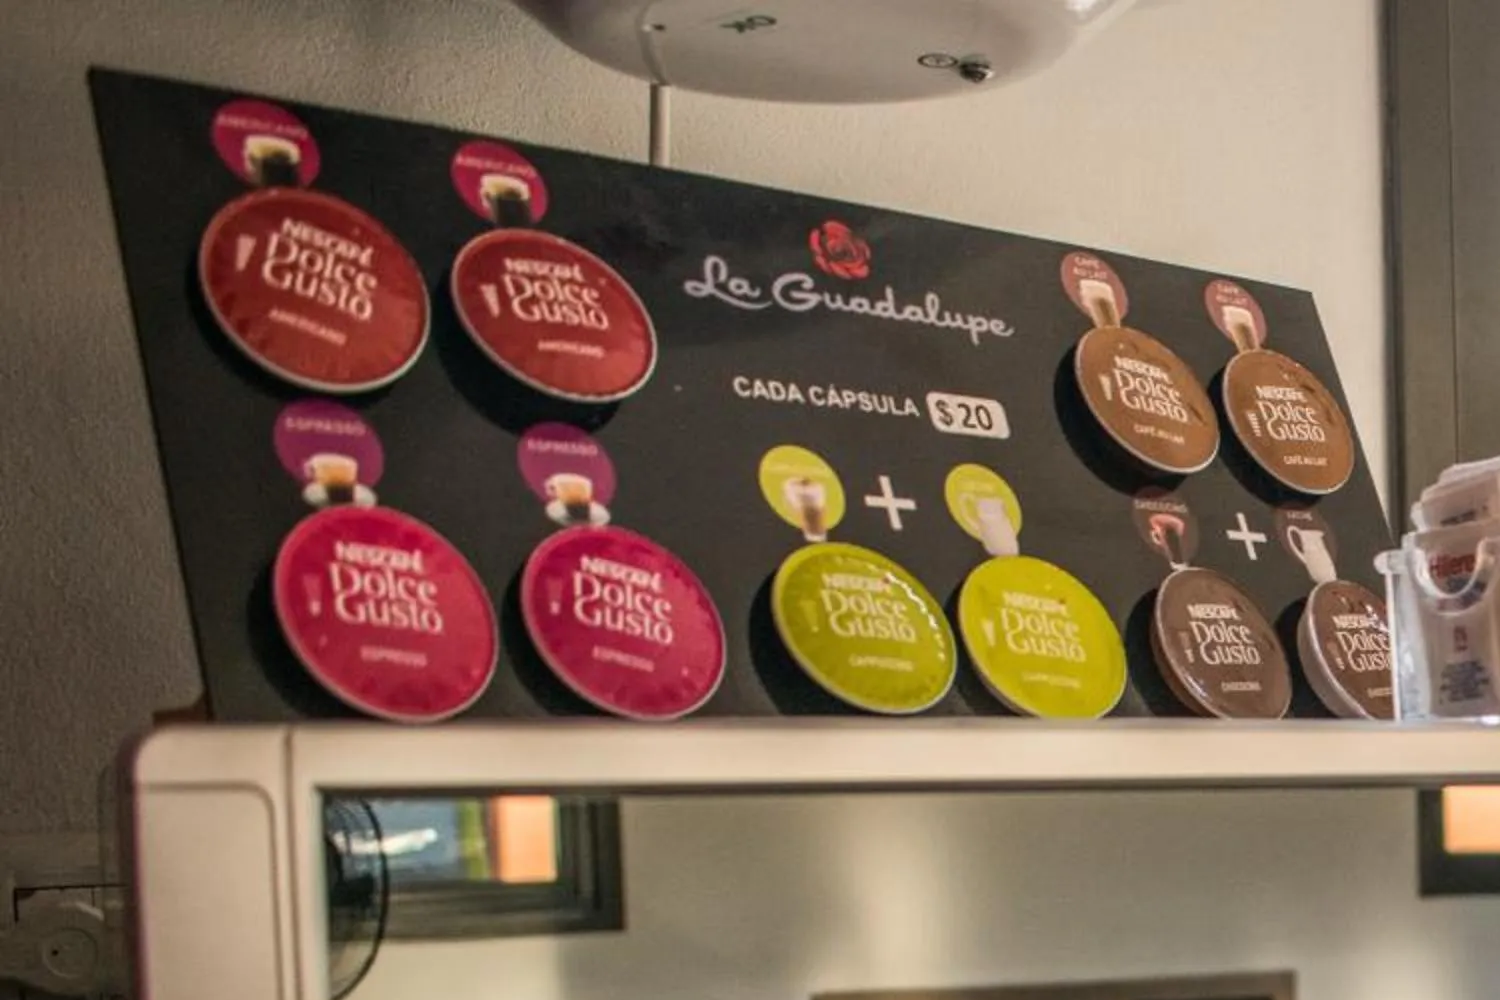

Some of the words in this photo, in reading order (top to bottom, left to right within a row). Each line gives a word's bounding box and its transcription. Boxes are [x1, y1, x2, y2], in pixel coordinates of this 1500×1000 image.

[266, 231, 378, 298] Dolce
[263, 258, 373, 321] Gusto
[503, 273, 600, 308] Dolce
[684, 256, 772, 310] La
[772, 273, 1015, 345] Guadalupe
[511, 296, 609, 331] Gusto
[733, 376, 805, 404] CADA
[808, 384, 920, 417] CÁPSULA
[1113, 369, 1182, 405] Dolce
[1120, 387, 1188, 422] Gusto
[1256, 400, 1320, 425] Dolce
[1266, 419, 1325, 442] Gusto
[330, 562, 438, 606] Dolce
[573, 569, 672, 622] Dolce
[335, 592, 443, 635] Gusto
[574, 597, 674, 646] Gusto
[821, 588, 908, 622] Dolce
[829, 614, 917, 643] Gusto
[1001, 607, 1081, 642] Dolce
[1189, 620, 1254, 645] Dolce
[1006, 631, 1087, 662] Gusto
[1200, 641, 1261, 665] Gusto
